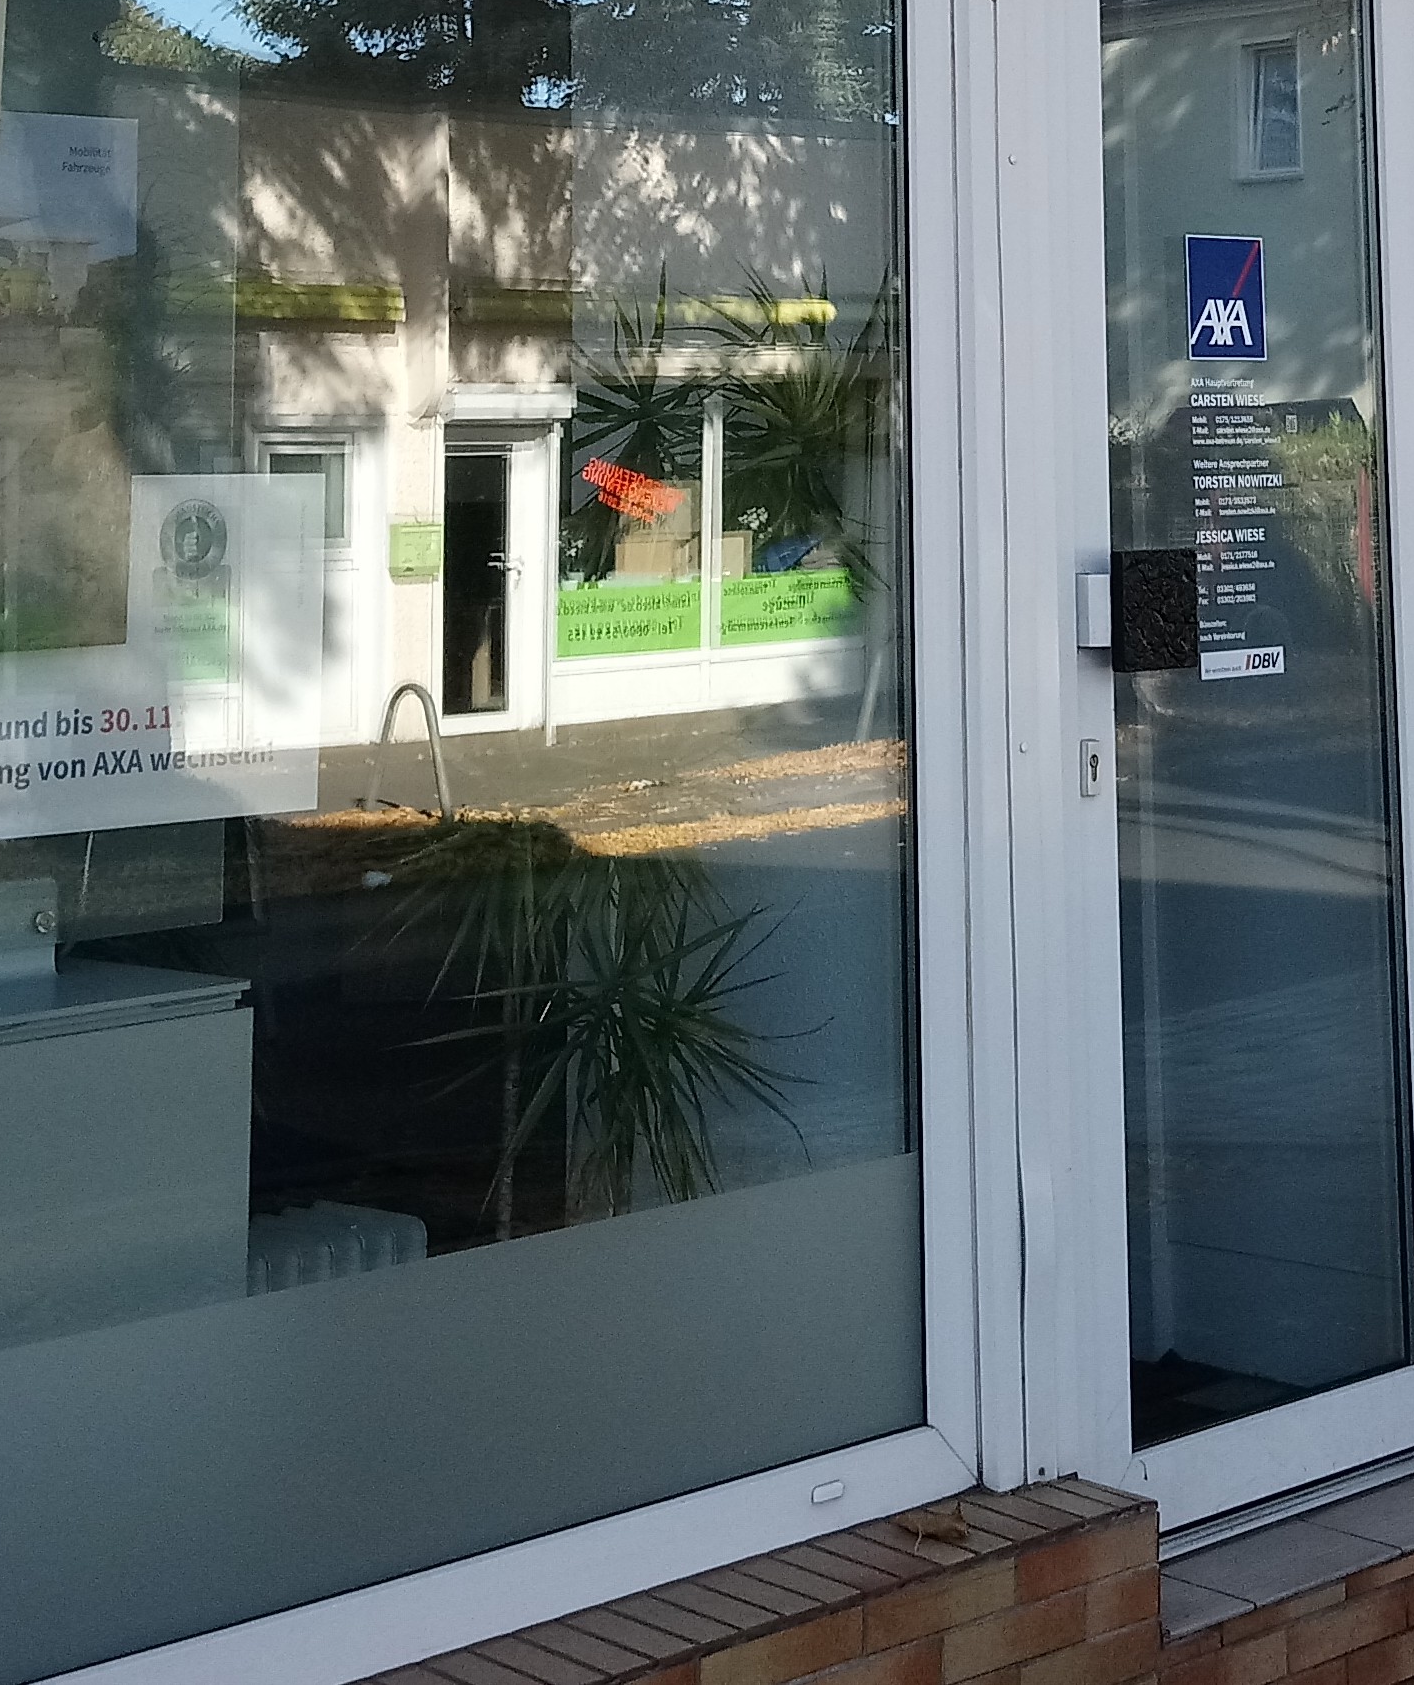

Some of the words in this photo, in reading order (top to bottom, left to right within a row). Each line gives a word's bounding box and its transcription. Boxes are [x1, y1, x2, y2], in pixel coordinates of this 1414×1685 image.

[1191, 299, 1253, 345] AXA
[1190, 393, 1234, 407] CARSTEN
[1235, 393, 1266, 407] WIESE
[1193, 475, 1236, 490] TORSTEN
[1237, 473, 1283, 489] NOWITZKI
[1195, 529, 1234, 544] JESSICA
[1235, 527, 1266, 543] WIESE
[1251, 651, 1280, 670] DBV
[54, 709, 94, 736] bis
[38, 757, 86, 783] von
[92, 748, 144, 777] AXA
